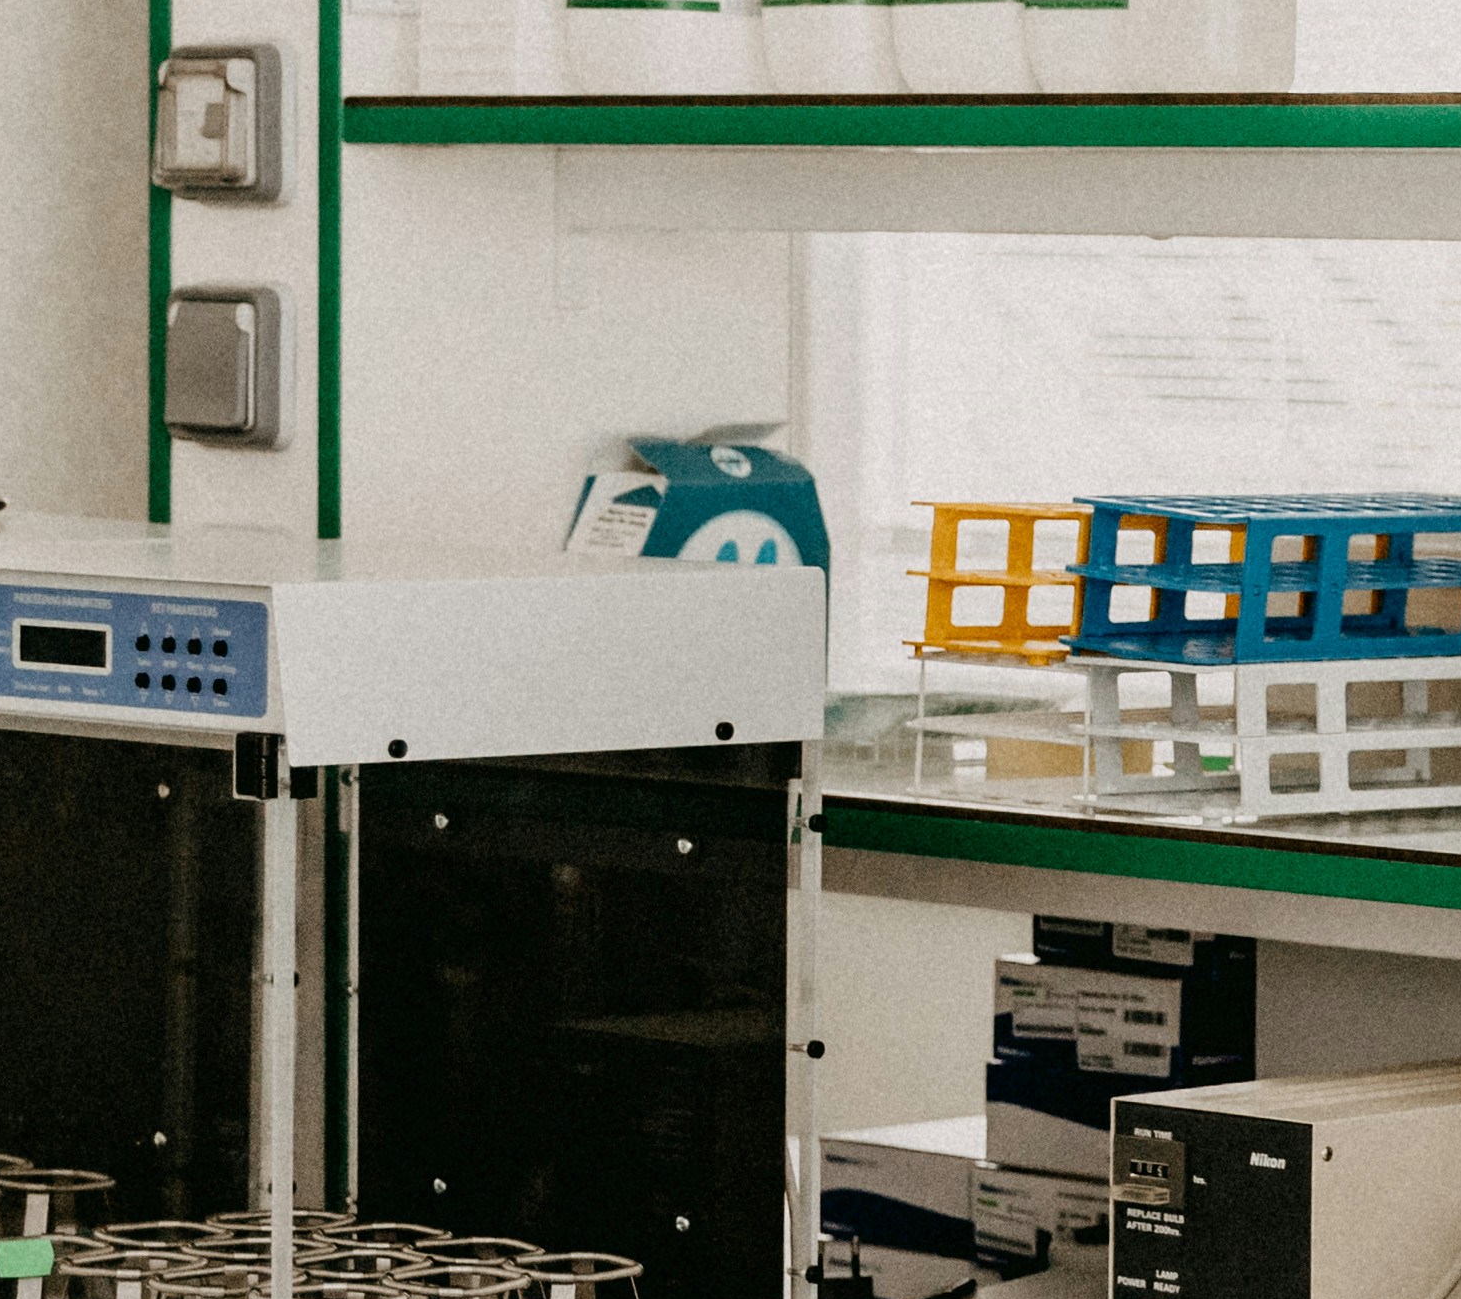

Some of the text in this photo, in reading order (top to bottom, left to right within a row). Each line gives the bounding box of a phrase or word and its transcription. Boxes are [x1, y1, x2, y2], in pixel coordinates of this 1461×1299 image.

[1134, 1127, 1173, 1141] RUN TIME
[1250, 1152, 1286, 1170] Nikon
[1127, 1207, 1185, 1225] REPLACE BULB
[1126, 1221, 1152, 1233] AFTER
[1116, 1275, 1146, 1289] POWER
[1156, 1269, 1179, 1281] LAMP
[1153, 1281, 1181, 1294] READY
